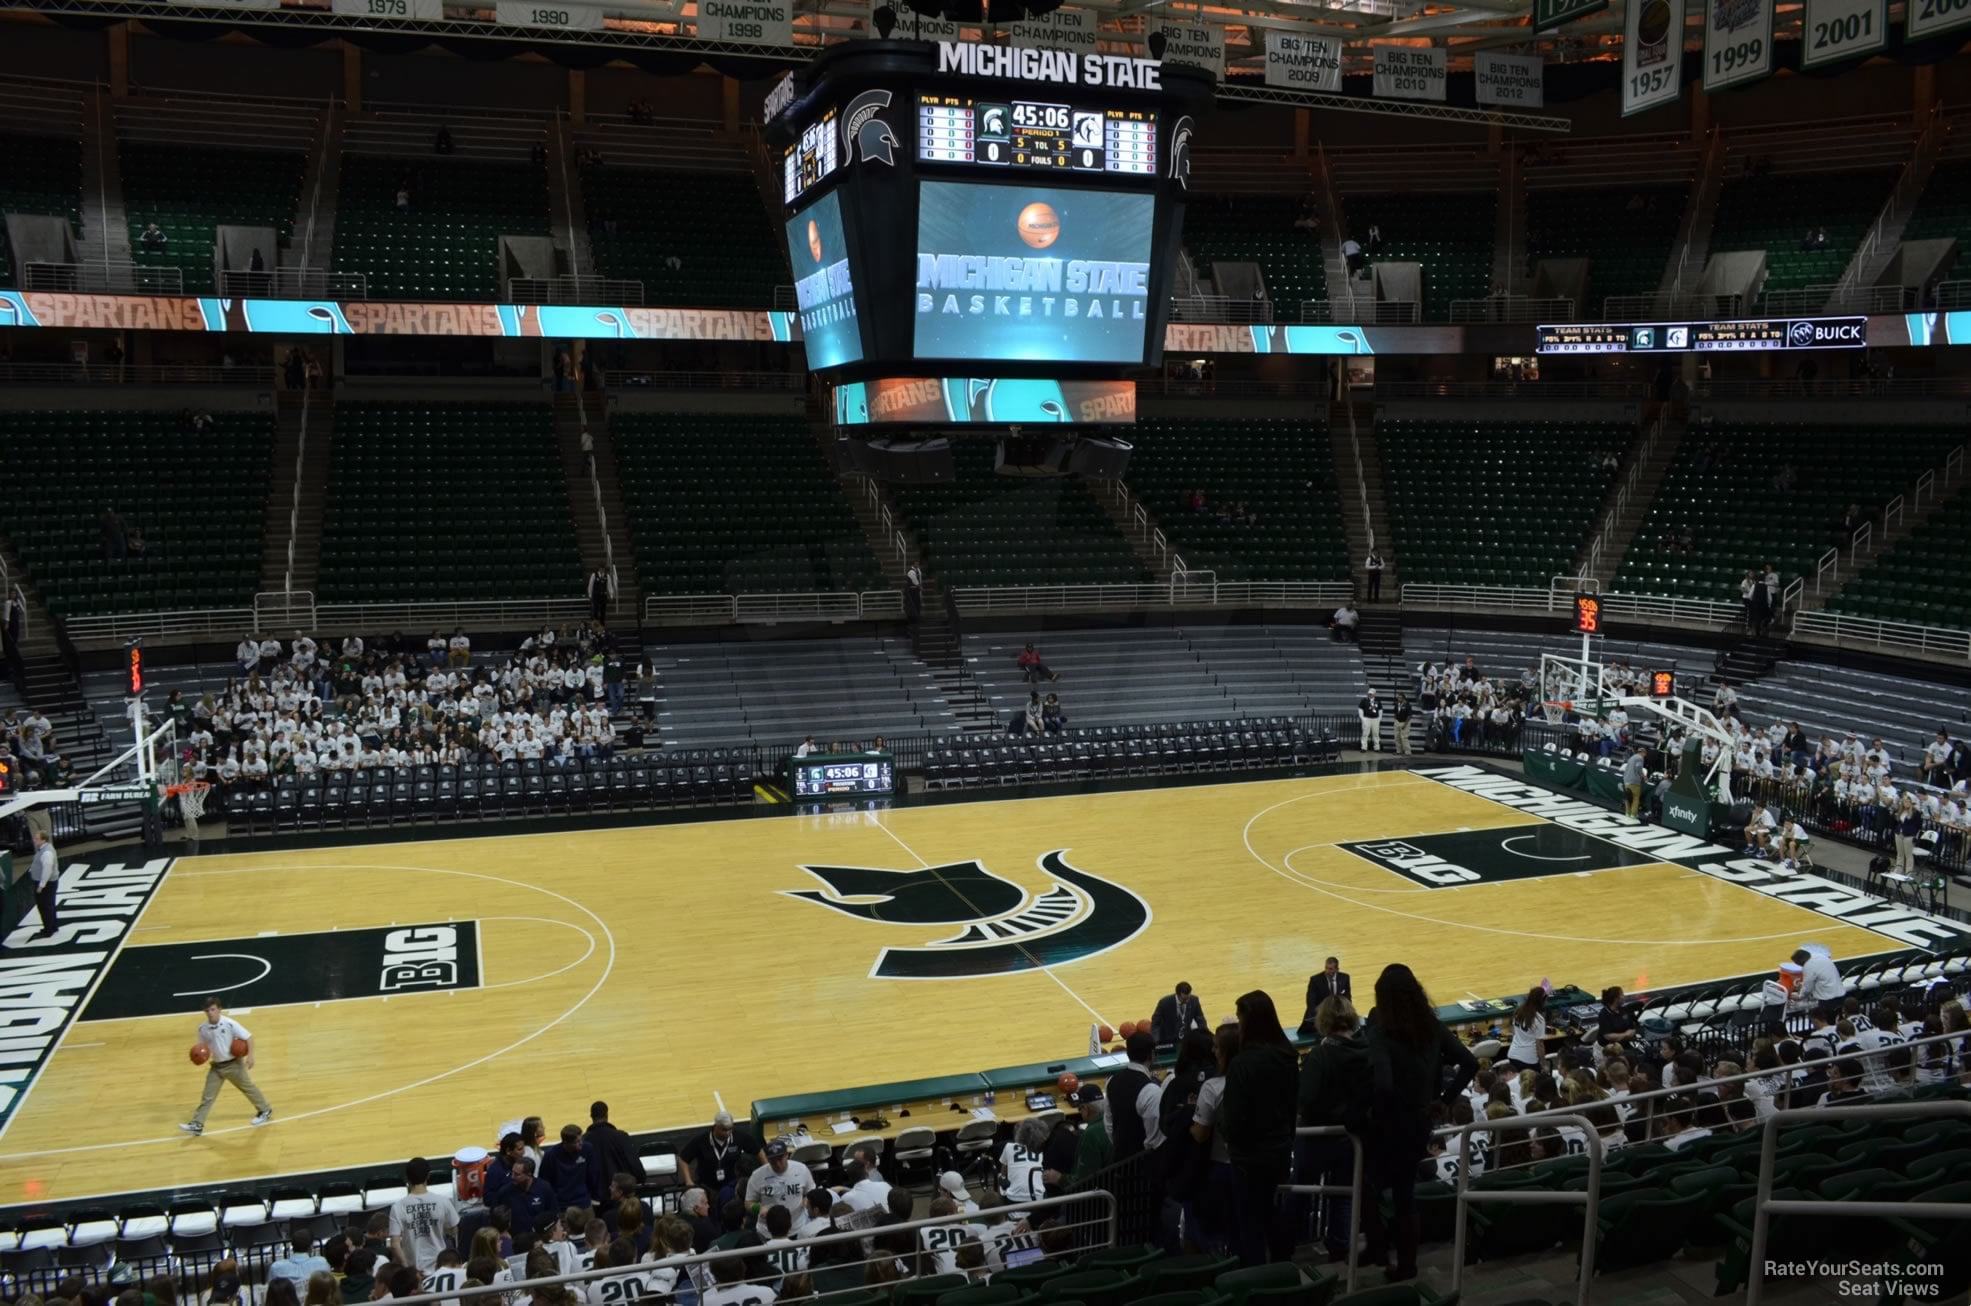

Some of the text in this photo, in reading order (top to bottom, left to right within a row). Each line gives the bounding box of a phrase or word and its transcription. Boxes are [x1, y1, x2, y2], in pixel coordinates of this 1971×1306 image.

[368, 0, 406, 14] 1979
[706, 2, 784, 22] CHAMPIONS
[532, 10, 568, 24] 1990
[1056, 12, 1082, 26] TEN
[728, 22, 762, 38] 1998
[1012, 24, 1095, 44] CHAMPIONS
[1162, 26, 1209, 42] BIG TEN
[1814, 8, 1872, 49] 2001
[1166, 43, 1220, 58] AMPIONS
[1282, 38, 1327, 53] BIG TEN
[1270, 52, 1338, 69] CHAMPIONS
[1388, 52, 1432, 66] BIG TEN
[1712, 38, 1762, 74] 1999
[938, 40, 1163, 90] MICHIGAN STATE
[1375, 64, 1444, 78] CHAMPIONS
[1490, 63, 1529, 76] BIG TEN
[1288, 69, 1320, 82] 2009
[1479, 74, 1540, 88] CHAMPIONS
[1630, 64, 1674, 98] 1957
[1395, 78, 1426, 90] 2010
[1496, 87, 1523, 99] 2012
[1012, 105, 1069, 128] 45:06
[1022, 128, 1054, 137] PERIOD
[988, 142, 999, 161] 0
[1017, 137, 1065, 150] 5 TOL 5
[1017, 153, 1065, 166] 0 FOULS 0
[1082, 150, 1094, 167] 0
[918, 253, 1150, 296] MICHIGAN STATE
[30, 294, 204, 331] SPARTANS
[918, 293, 1144, 319] BASKETBALL
[346, 302, 499, 337] SPARTANS
[800, 297, 856, 333] BASKETBALL
[630, 310, 772, 341] SPARTANS
[1815, 326, 1861, 340] BUICK
[1580, 610, 1596, 630] 35
[827, 767, 859, 779] 45:06
[812, 784, 819, 792] 0
[1669, 805, 1697, 824] xfinity
[1408, 764, 1971, 948] MICHIGAN STATE
[2, 857, 171, 949] STATE
[1852, 1016, 1873, 1032] 20
[467, 1170, 480, 1183] G
[787, 1184, 800, 1195] NE
[406, 1203, 436, 1214] EXPECT
[928, 1228, 967, 1253] 20
[994, 1234, 1034, 1263] 20
[601, 1277, 644, 1306] 20
